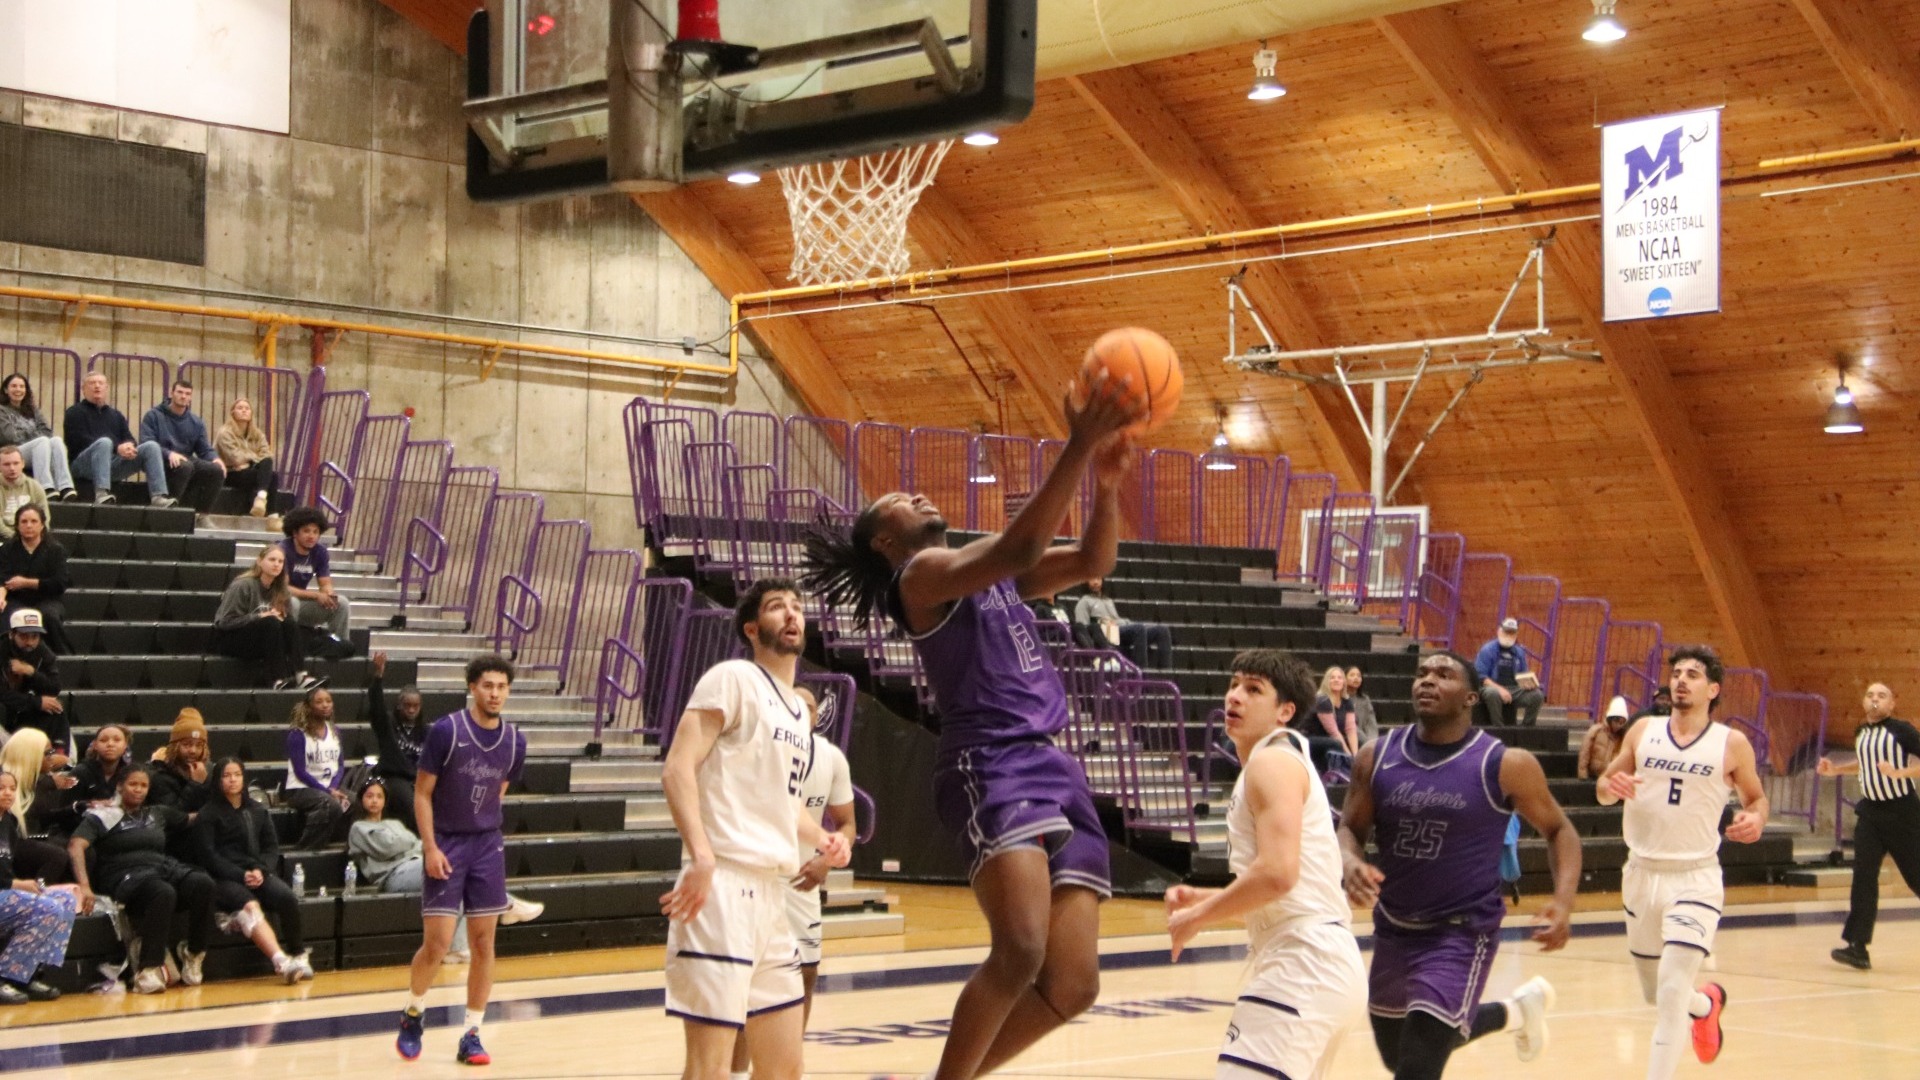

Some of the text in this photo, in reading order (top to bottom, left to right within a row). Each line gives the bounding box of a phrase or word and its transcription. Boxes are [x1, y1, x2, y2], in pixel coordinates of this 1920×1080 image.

[1642, 195, 1679, 218] 1984
[1616, 215, 1705, 238] MEN'S BASKETBALL
[1639, 235, 1682, 262] NCAA
[1008, 622, 1043, 673] 12
[773, 727, 812, 754] EAGL
[1644, 756, 1715, 777] EAGLES
[470, 785, 488, 815] 4
[1383, 781, 1468, 815] Majors
[1668, 777, 1684, 806] 6
[1393, 819, 1449, 860] 25
